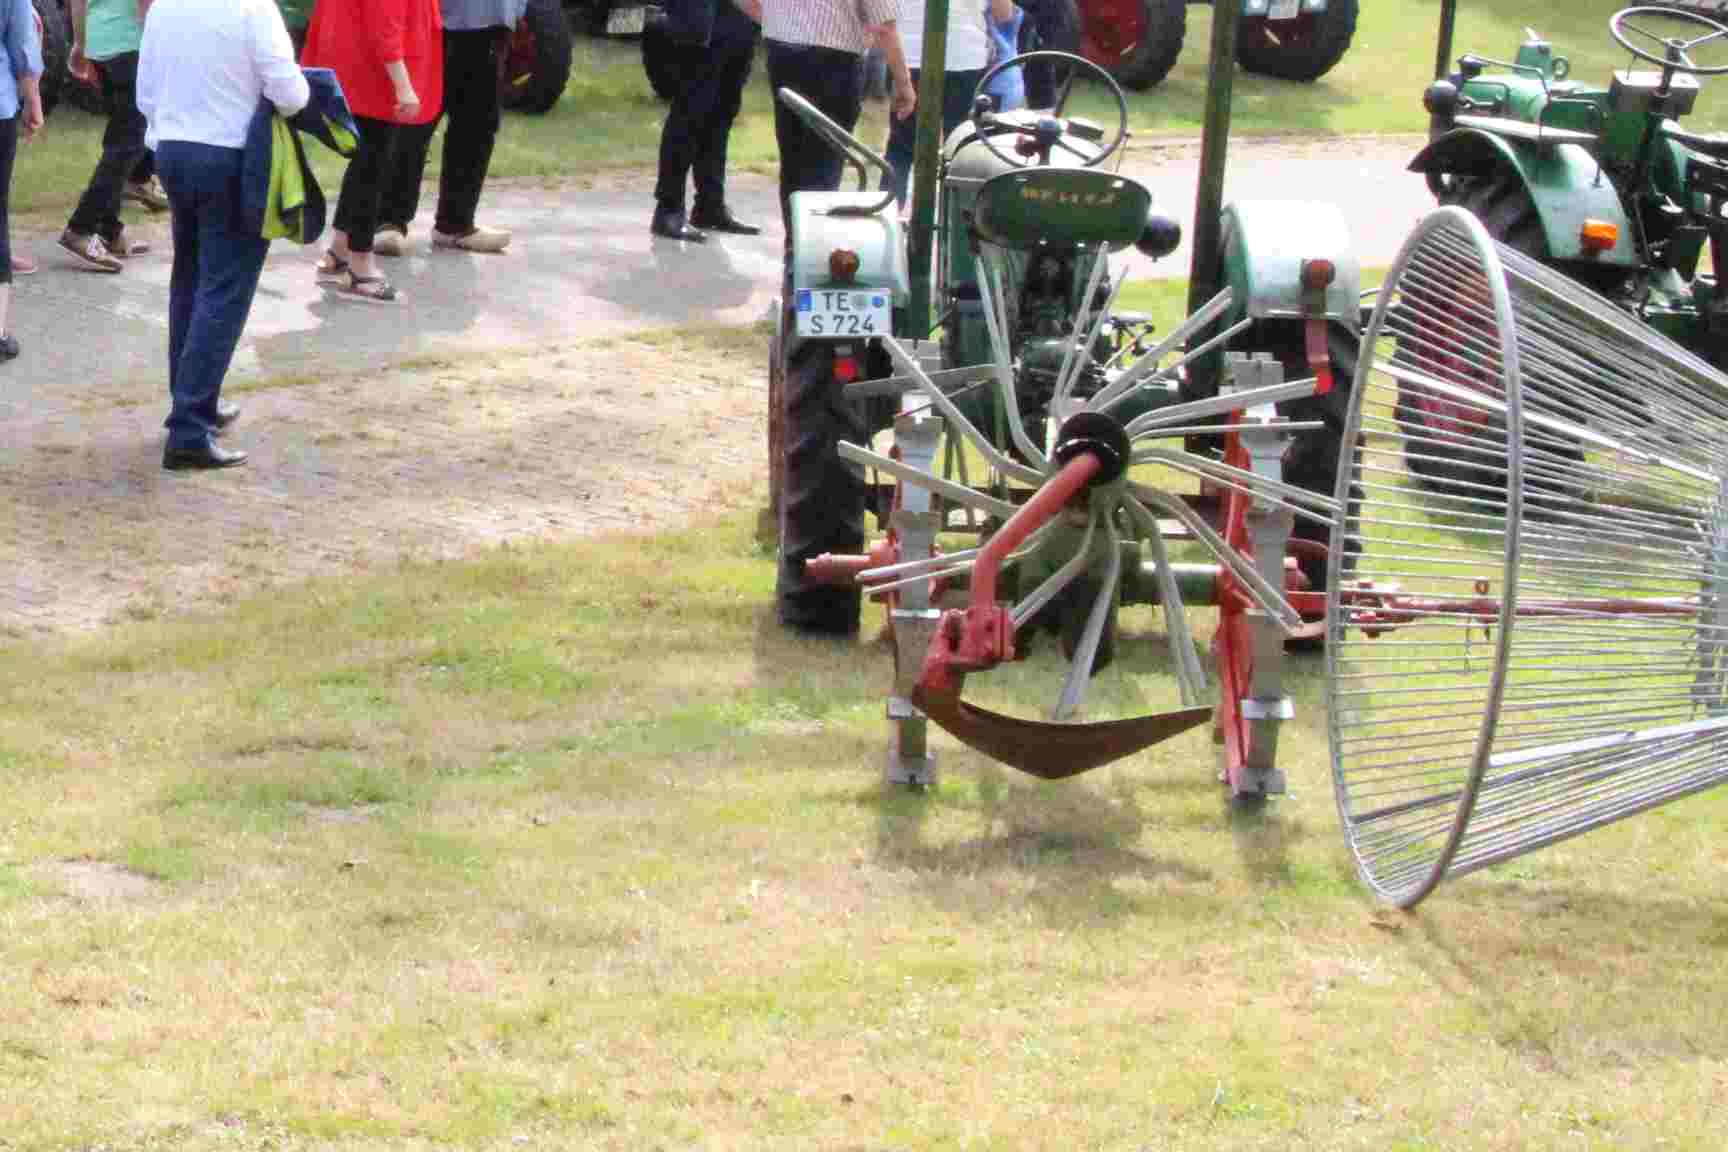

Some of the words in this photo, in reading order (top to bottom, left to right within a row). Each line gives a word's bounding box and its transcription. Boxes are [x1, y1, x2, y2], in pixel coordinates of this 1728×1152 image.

[823, 291, 850, 311] TE
[810, 315, 823, 334] S
[833, 314, 875, 334] 724
